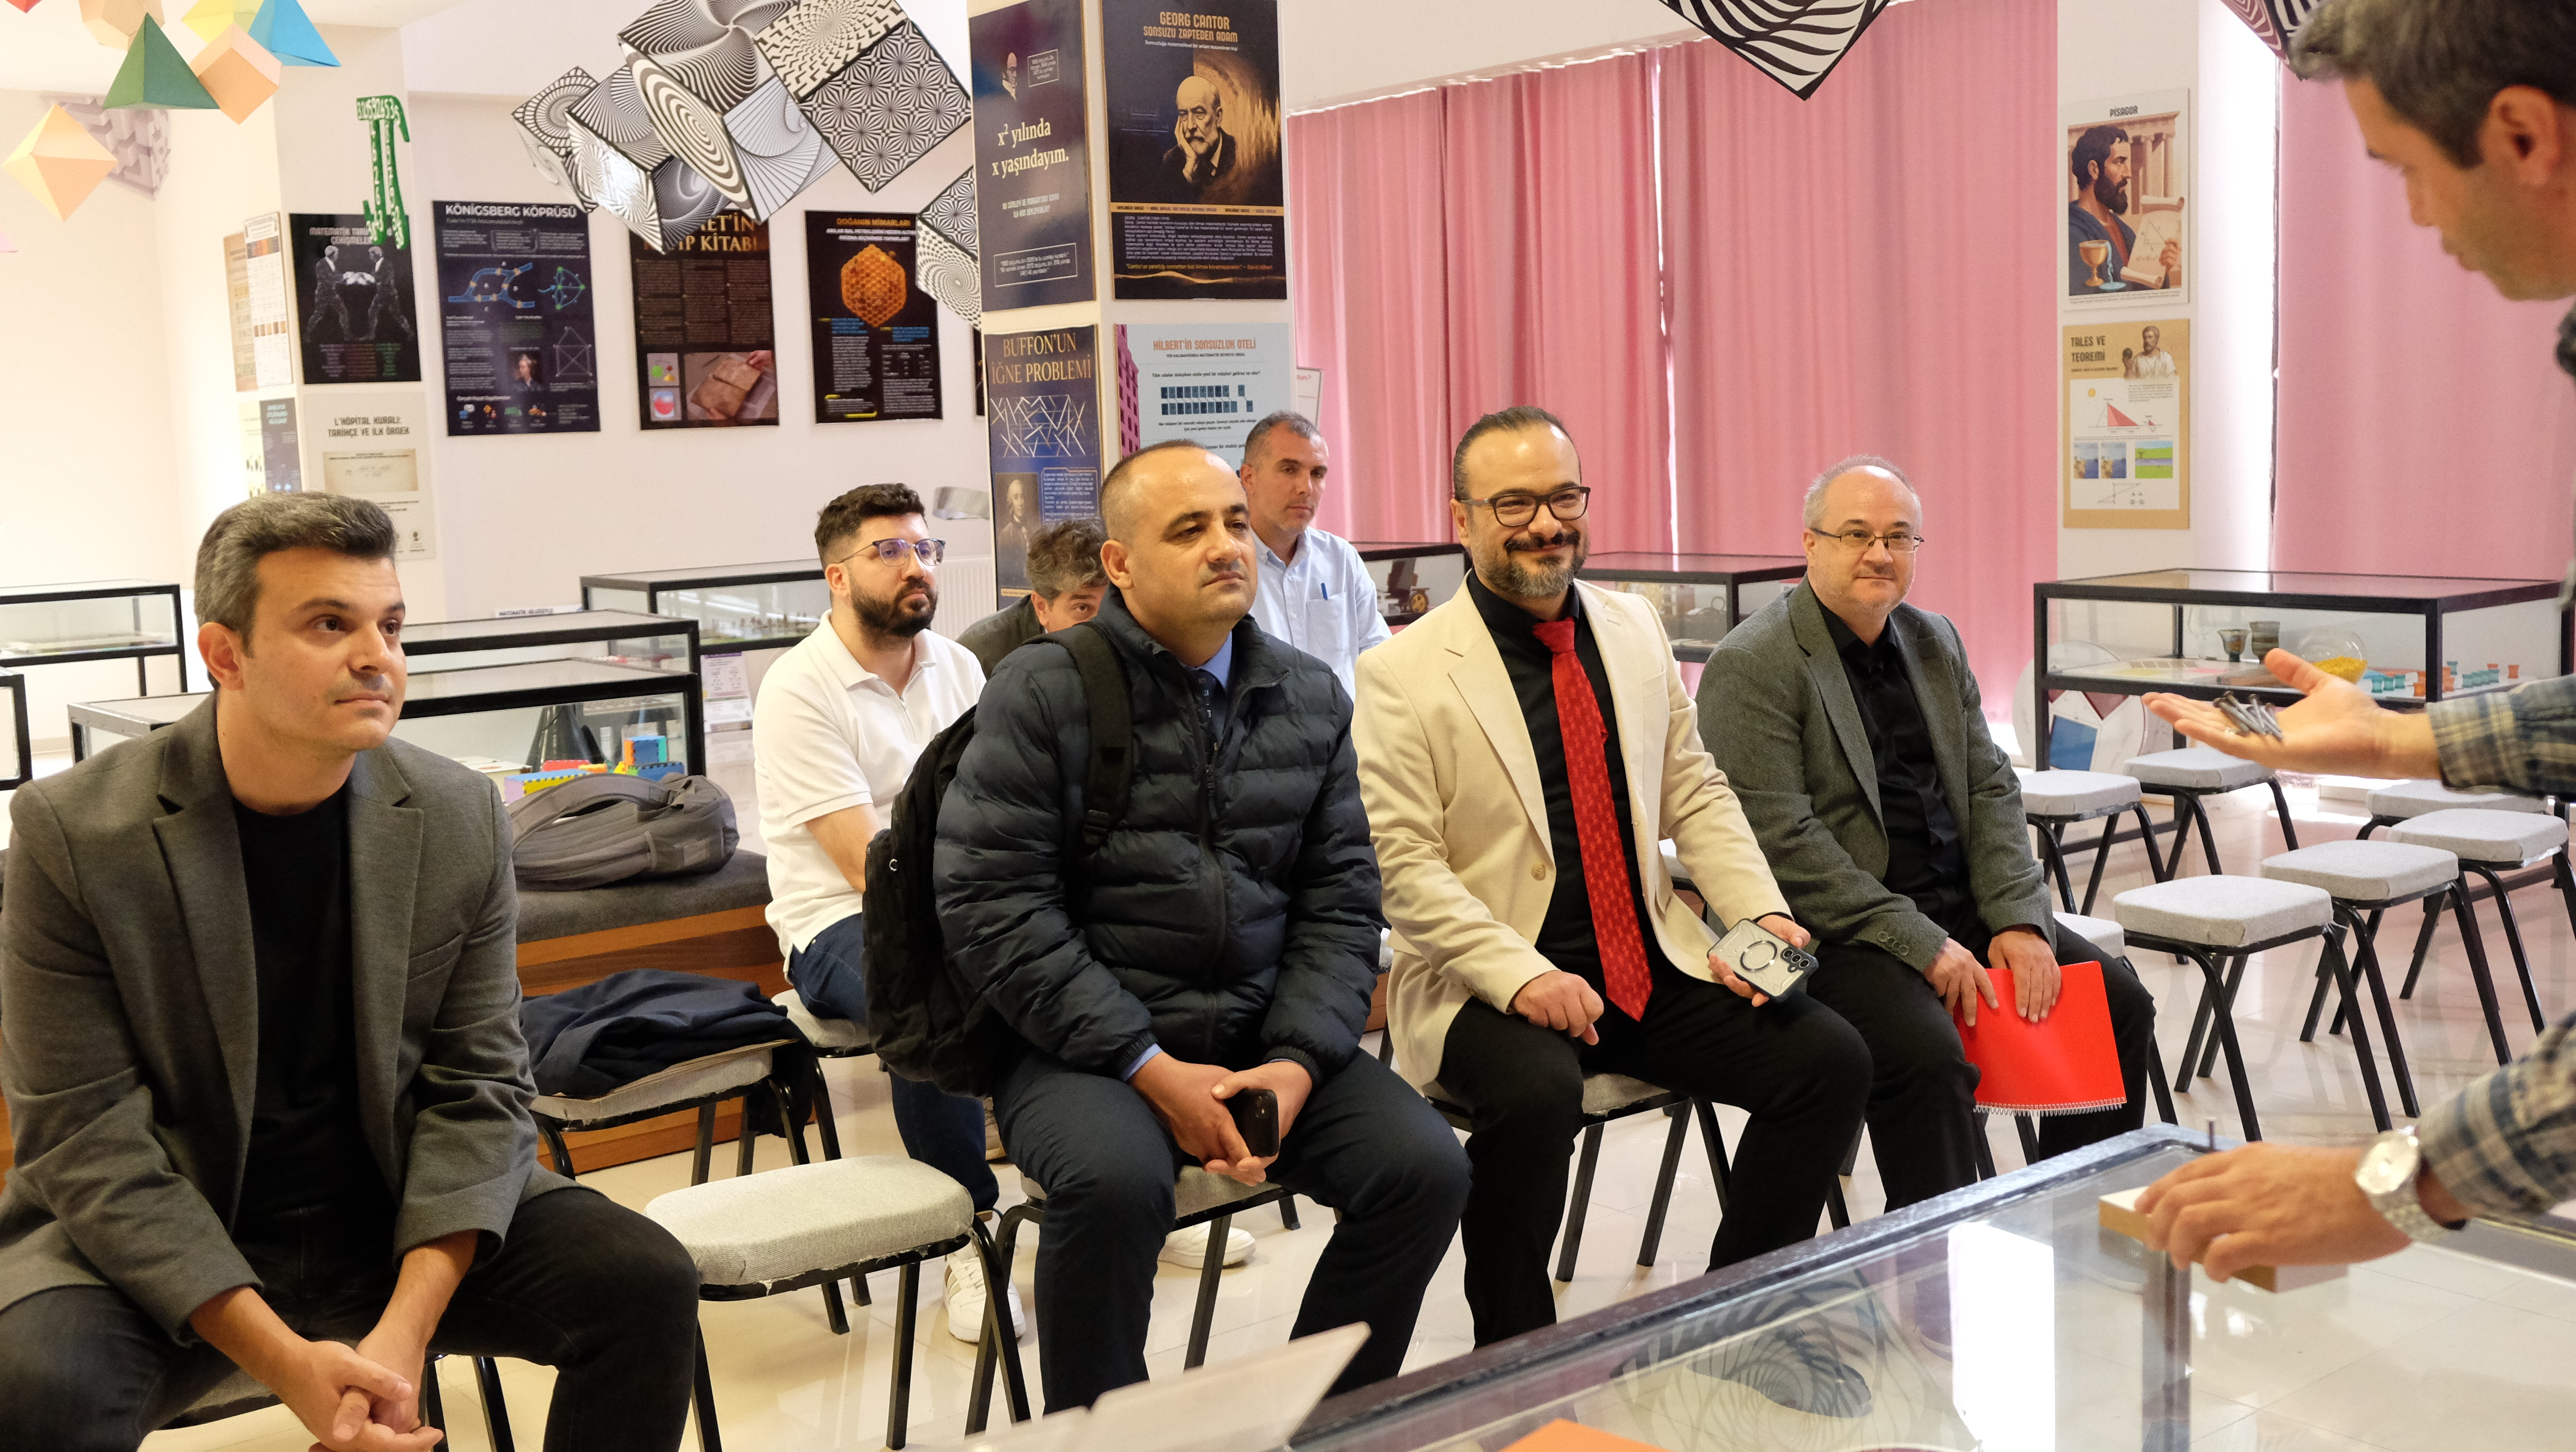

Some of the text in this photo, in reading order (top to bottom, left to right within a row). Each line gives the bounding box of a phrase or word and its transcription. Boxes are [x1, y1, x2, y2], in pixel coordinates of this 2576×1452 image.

[1160, 11, 1230, 30] GEORG CANTOR
[1143, 26, 1238, 43] SONSUZU ZAPTEDEN ADAM
[2109, 105, 2138, 117] PİSAGOR
[1011, 117, 1052, 148] yılında
[992, 148, 1070, 179] x yaşındayım.
[445, 203, 578, 218] KÖNİGSBERG KÖPRÜSÜ
[701, 212, 756, 232] ET'İN
[837, 217, 911, 227] DOĞANIN MİMARLARI
[309, 226, 350, 236] MATEMATİK
[700, 233, 758, 252] KİTABI
[1003, 332, 1076, 357] BUFFON'UN
[1153, 337, 1257, 351] HİLBERT'İN SONSUZLUK OTELİ
[2071, 335, 2106, 347] TALES VE
[2071, 349, 2106, 362] TEOREMİ
[992, 354, 1092, 384] İĞNE PROBLEMİ
[328, 425, 410, 438] TARİHÇE VE İLK ÖRNEK
